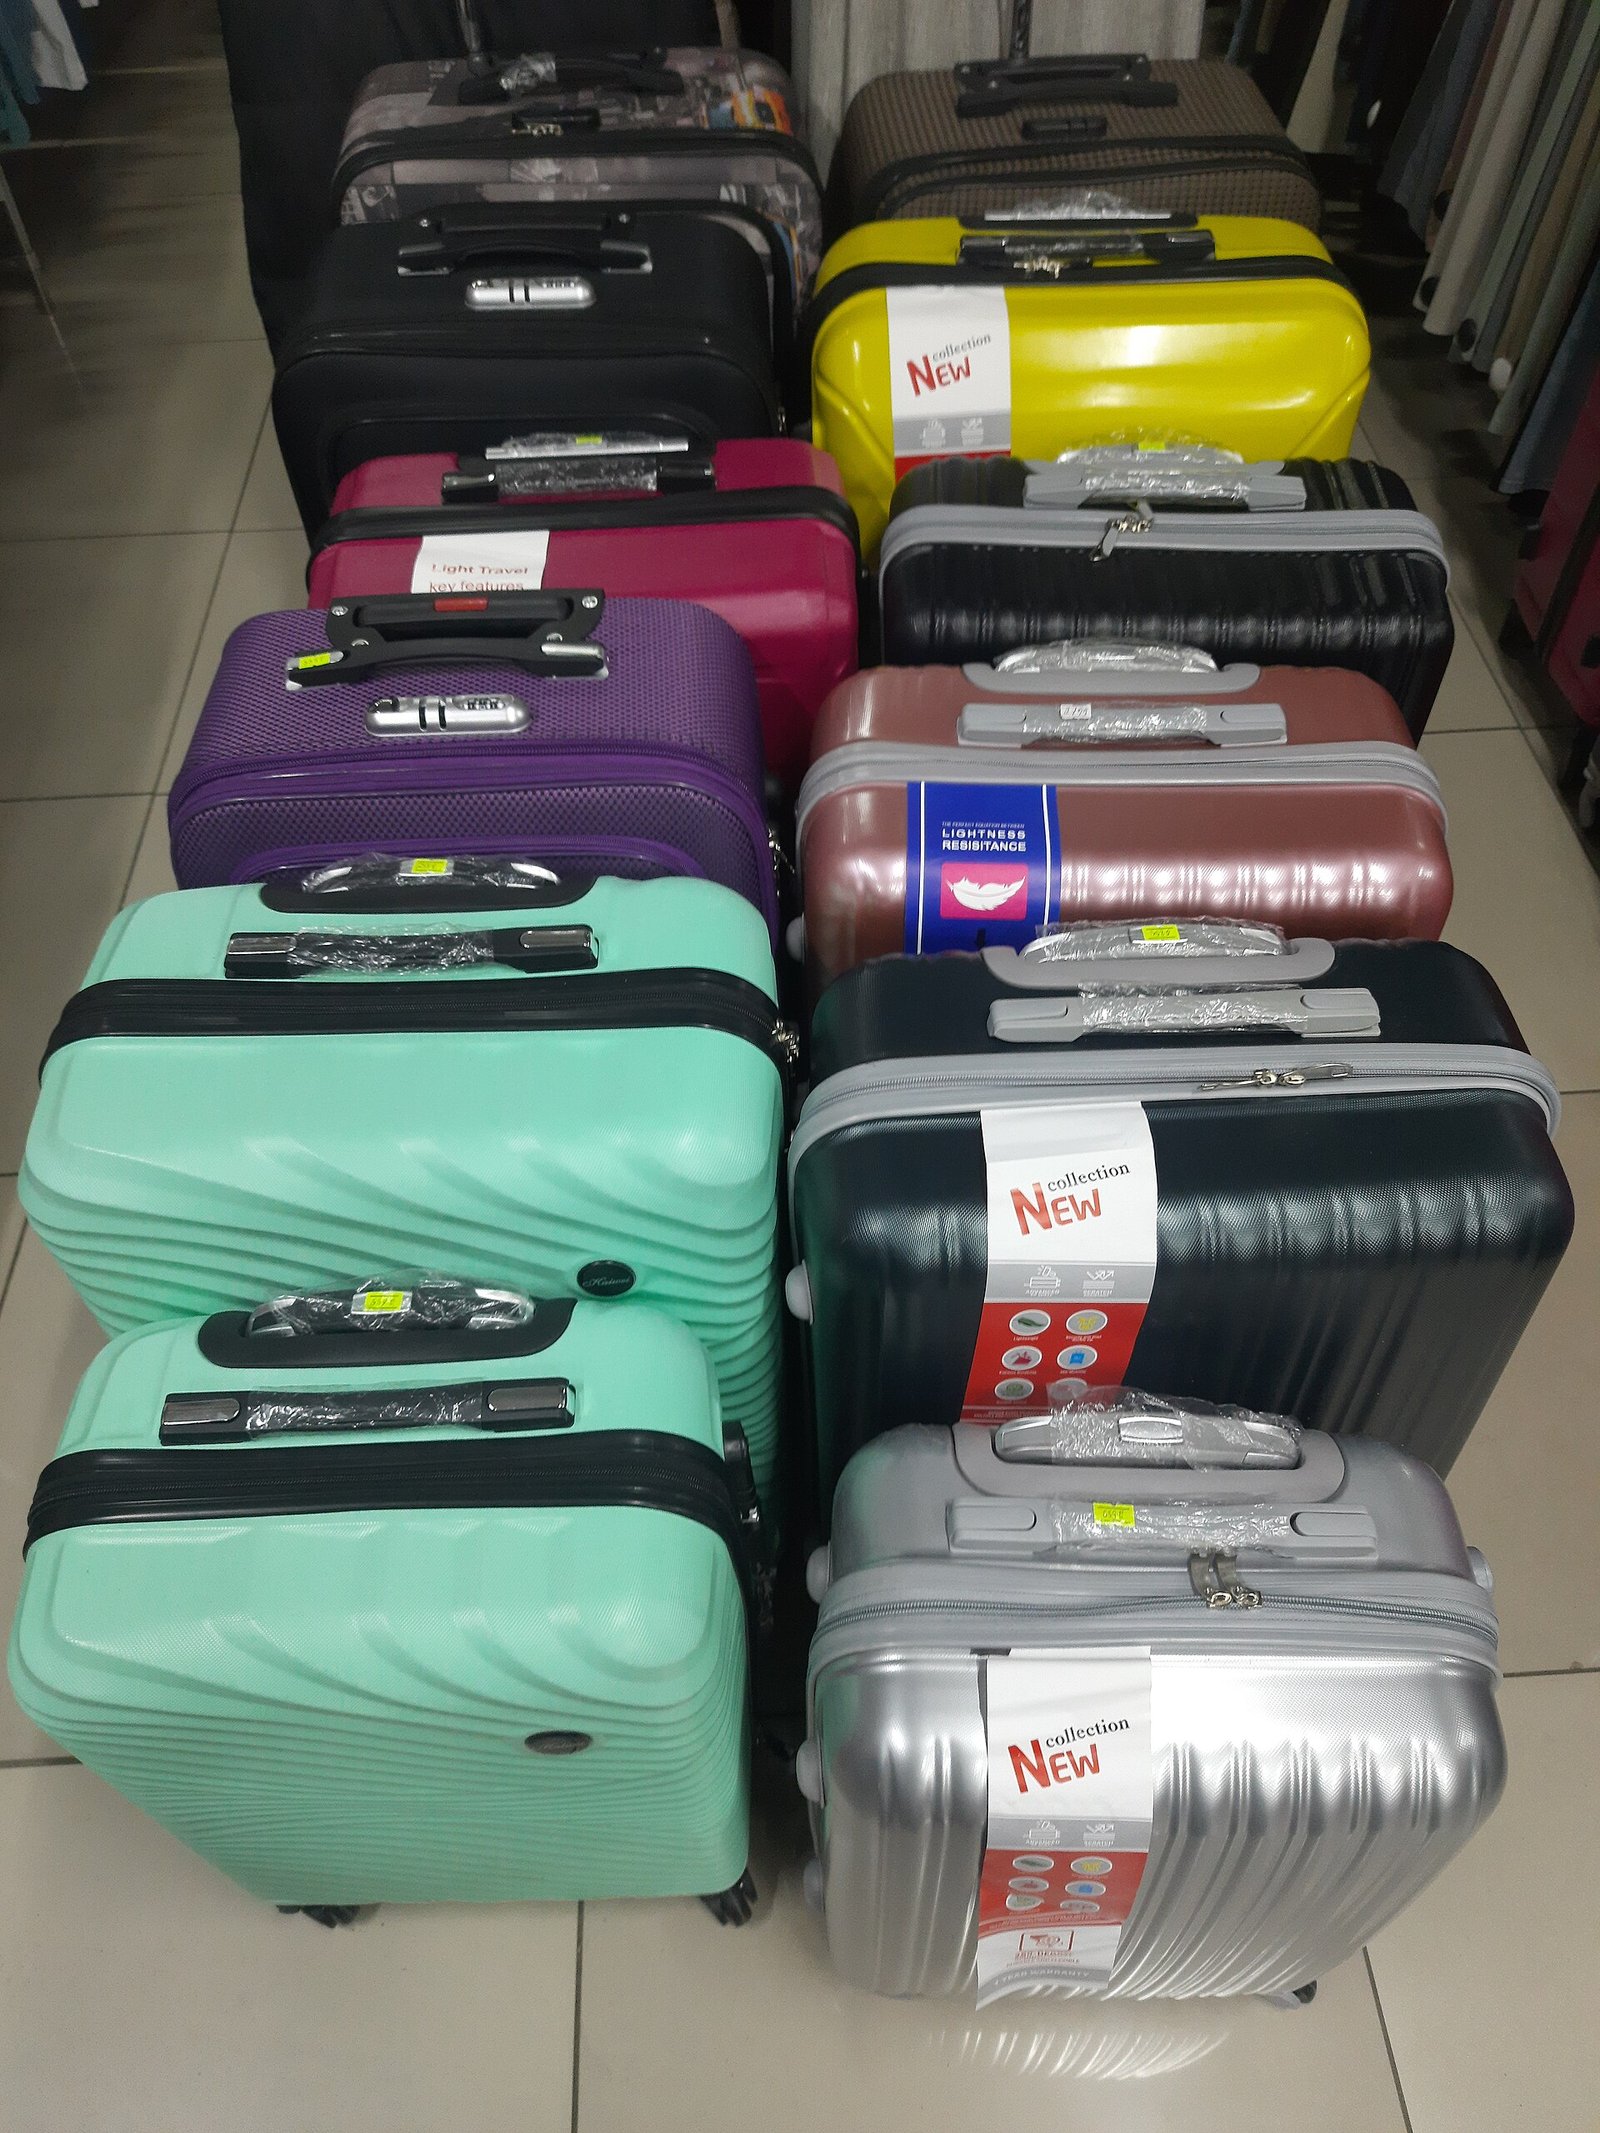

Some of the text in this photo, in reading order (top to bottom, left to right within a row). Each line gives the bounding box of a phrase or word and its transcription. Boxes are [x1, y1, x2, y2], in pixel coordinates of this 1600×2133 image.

[933, 334, 991, 361] collection
[906, 354, 971, 397] NEW
[431, 563, 528, 575] Light Travel
[429, 580, 524, 592] key features
[942, 829, 1026, 839] LIGHTNESS
[1047, 1163, 1131, 1192] collection
[1009, 1182, 1102, 1236] NEW
[1045, 1717, 1131, 1749] collection
[1007, 1738, 1101, 1795] NEW
